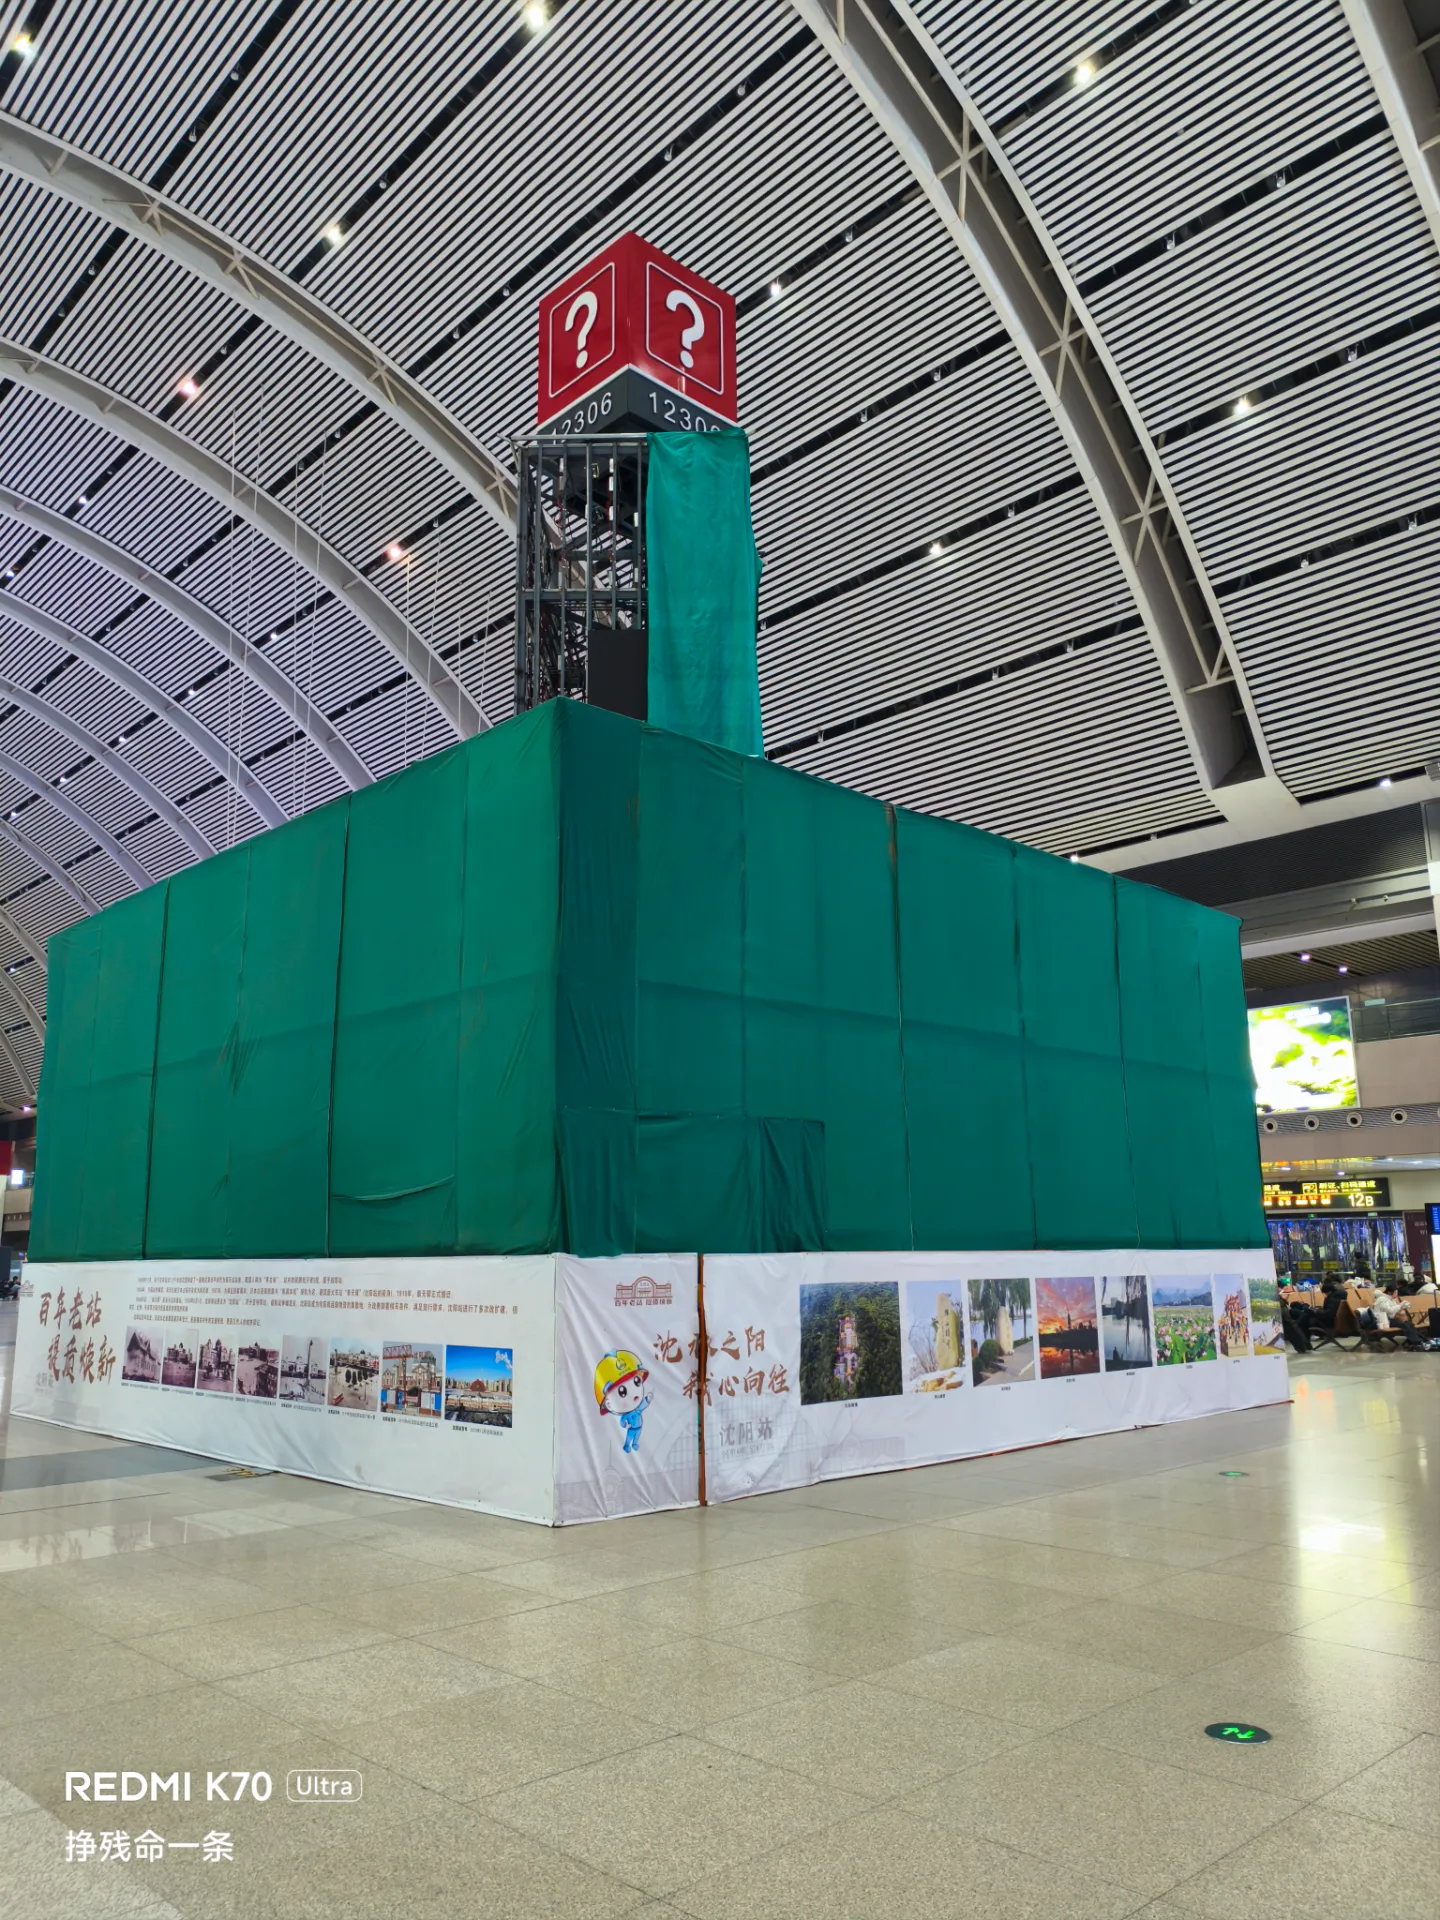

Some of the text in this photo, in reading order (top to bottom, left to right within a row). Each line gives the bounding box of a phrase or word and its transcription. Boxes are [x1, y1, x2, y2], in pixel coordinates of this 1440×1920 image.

[1348, 1193, 1374, 1207] 12B
[40, 1286, 102, 1330] 百年老站
[682, 1364, 790, 1407] 我心向往
[719, 1416, 773, 1447] 沈阳站
